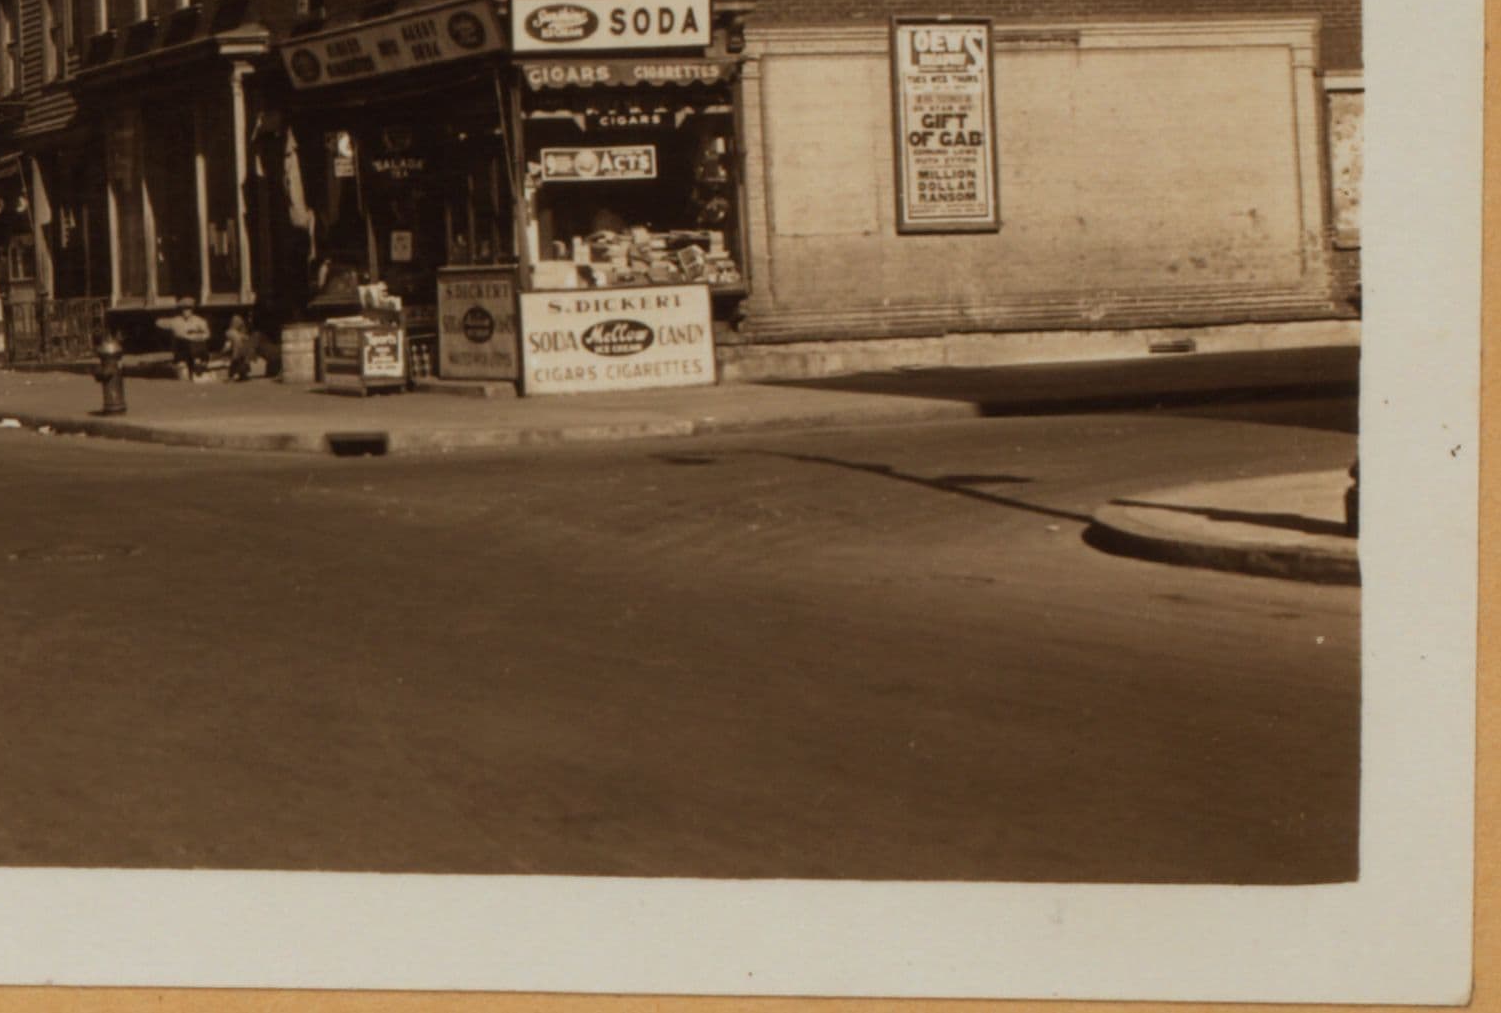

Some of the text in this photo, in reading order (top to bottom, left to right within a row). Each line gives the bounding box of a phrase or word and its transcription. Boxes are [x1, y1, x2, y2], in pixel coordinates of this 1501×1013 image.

[609, 6, 699, 36] SODA
[528, 63, 720, 85] CIGARS CIGARETTES
[599, 114, 661, 127] CIGARS
[921, 113, 968, 129] GIFT
[909, 131, 983, 148] OF GAB
[917, 170, 977, 180] MILLION
[917, 180, 976, 192] DOLLAR
[918, 191, 977, 203] RANSOM
[528, 331, 581, 354] SODA
[658, 323, 704, 346] CANDY
[533, 358, 704, 384] CIGARS CIGARETTES
